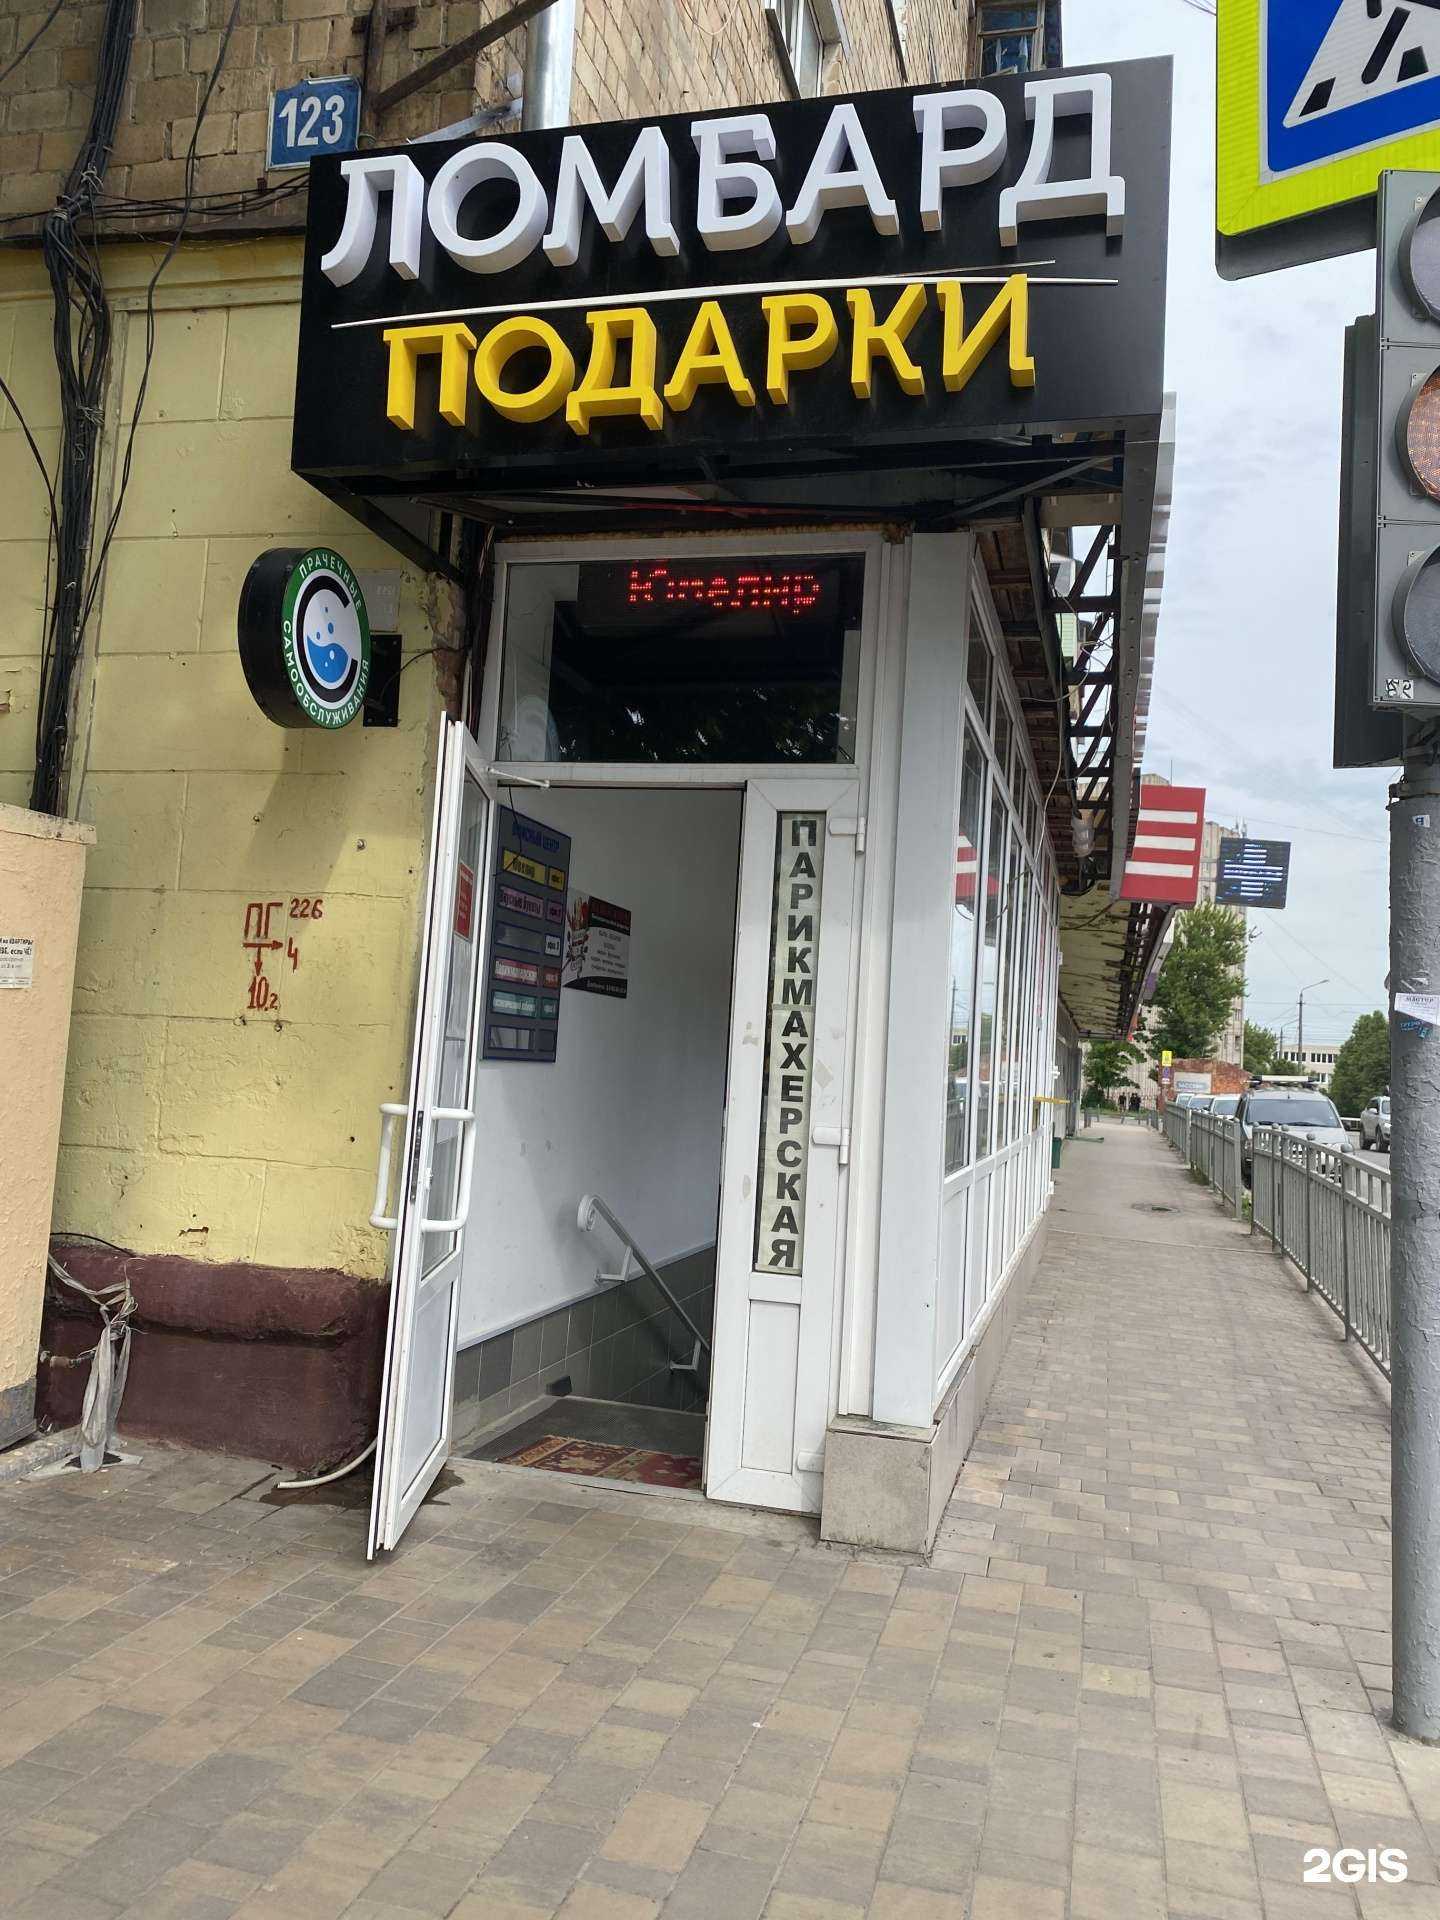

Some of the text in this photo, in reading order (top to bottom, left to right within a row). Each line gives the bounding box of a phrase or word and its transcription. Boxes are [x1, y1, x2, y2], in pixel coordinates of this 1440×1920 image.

[278, 94, 345, 148] 123
[321, 73, 1125, 288] ЛОМБАРД
[382, 274, 1037, 435] ПОДАРКИ
[298, 553, 362, 611] ПРАЧЕЧНЫЕ
[283, 619, 369, 725] САМООБСЛУЖИВАНИЯ
[244, 898, 323, 939] ПГ 226
[287, 937, 298, 973] 4
[768, 819, 818, 1268] ПАРИКМАХЕРСКАЯ
